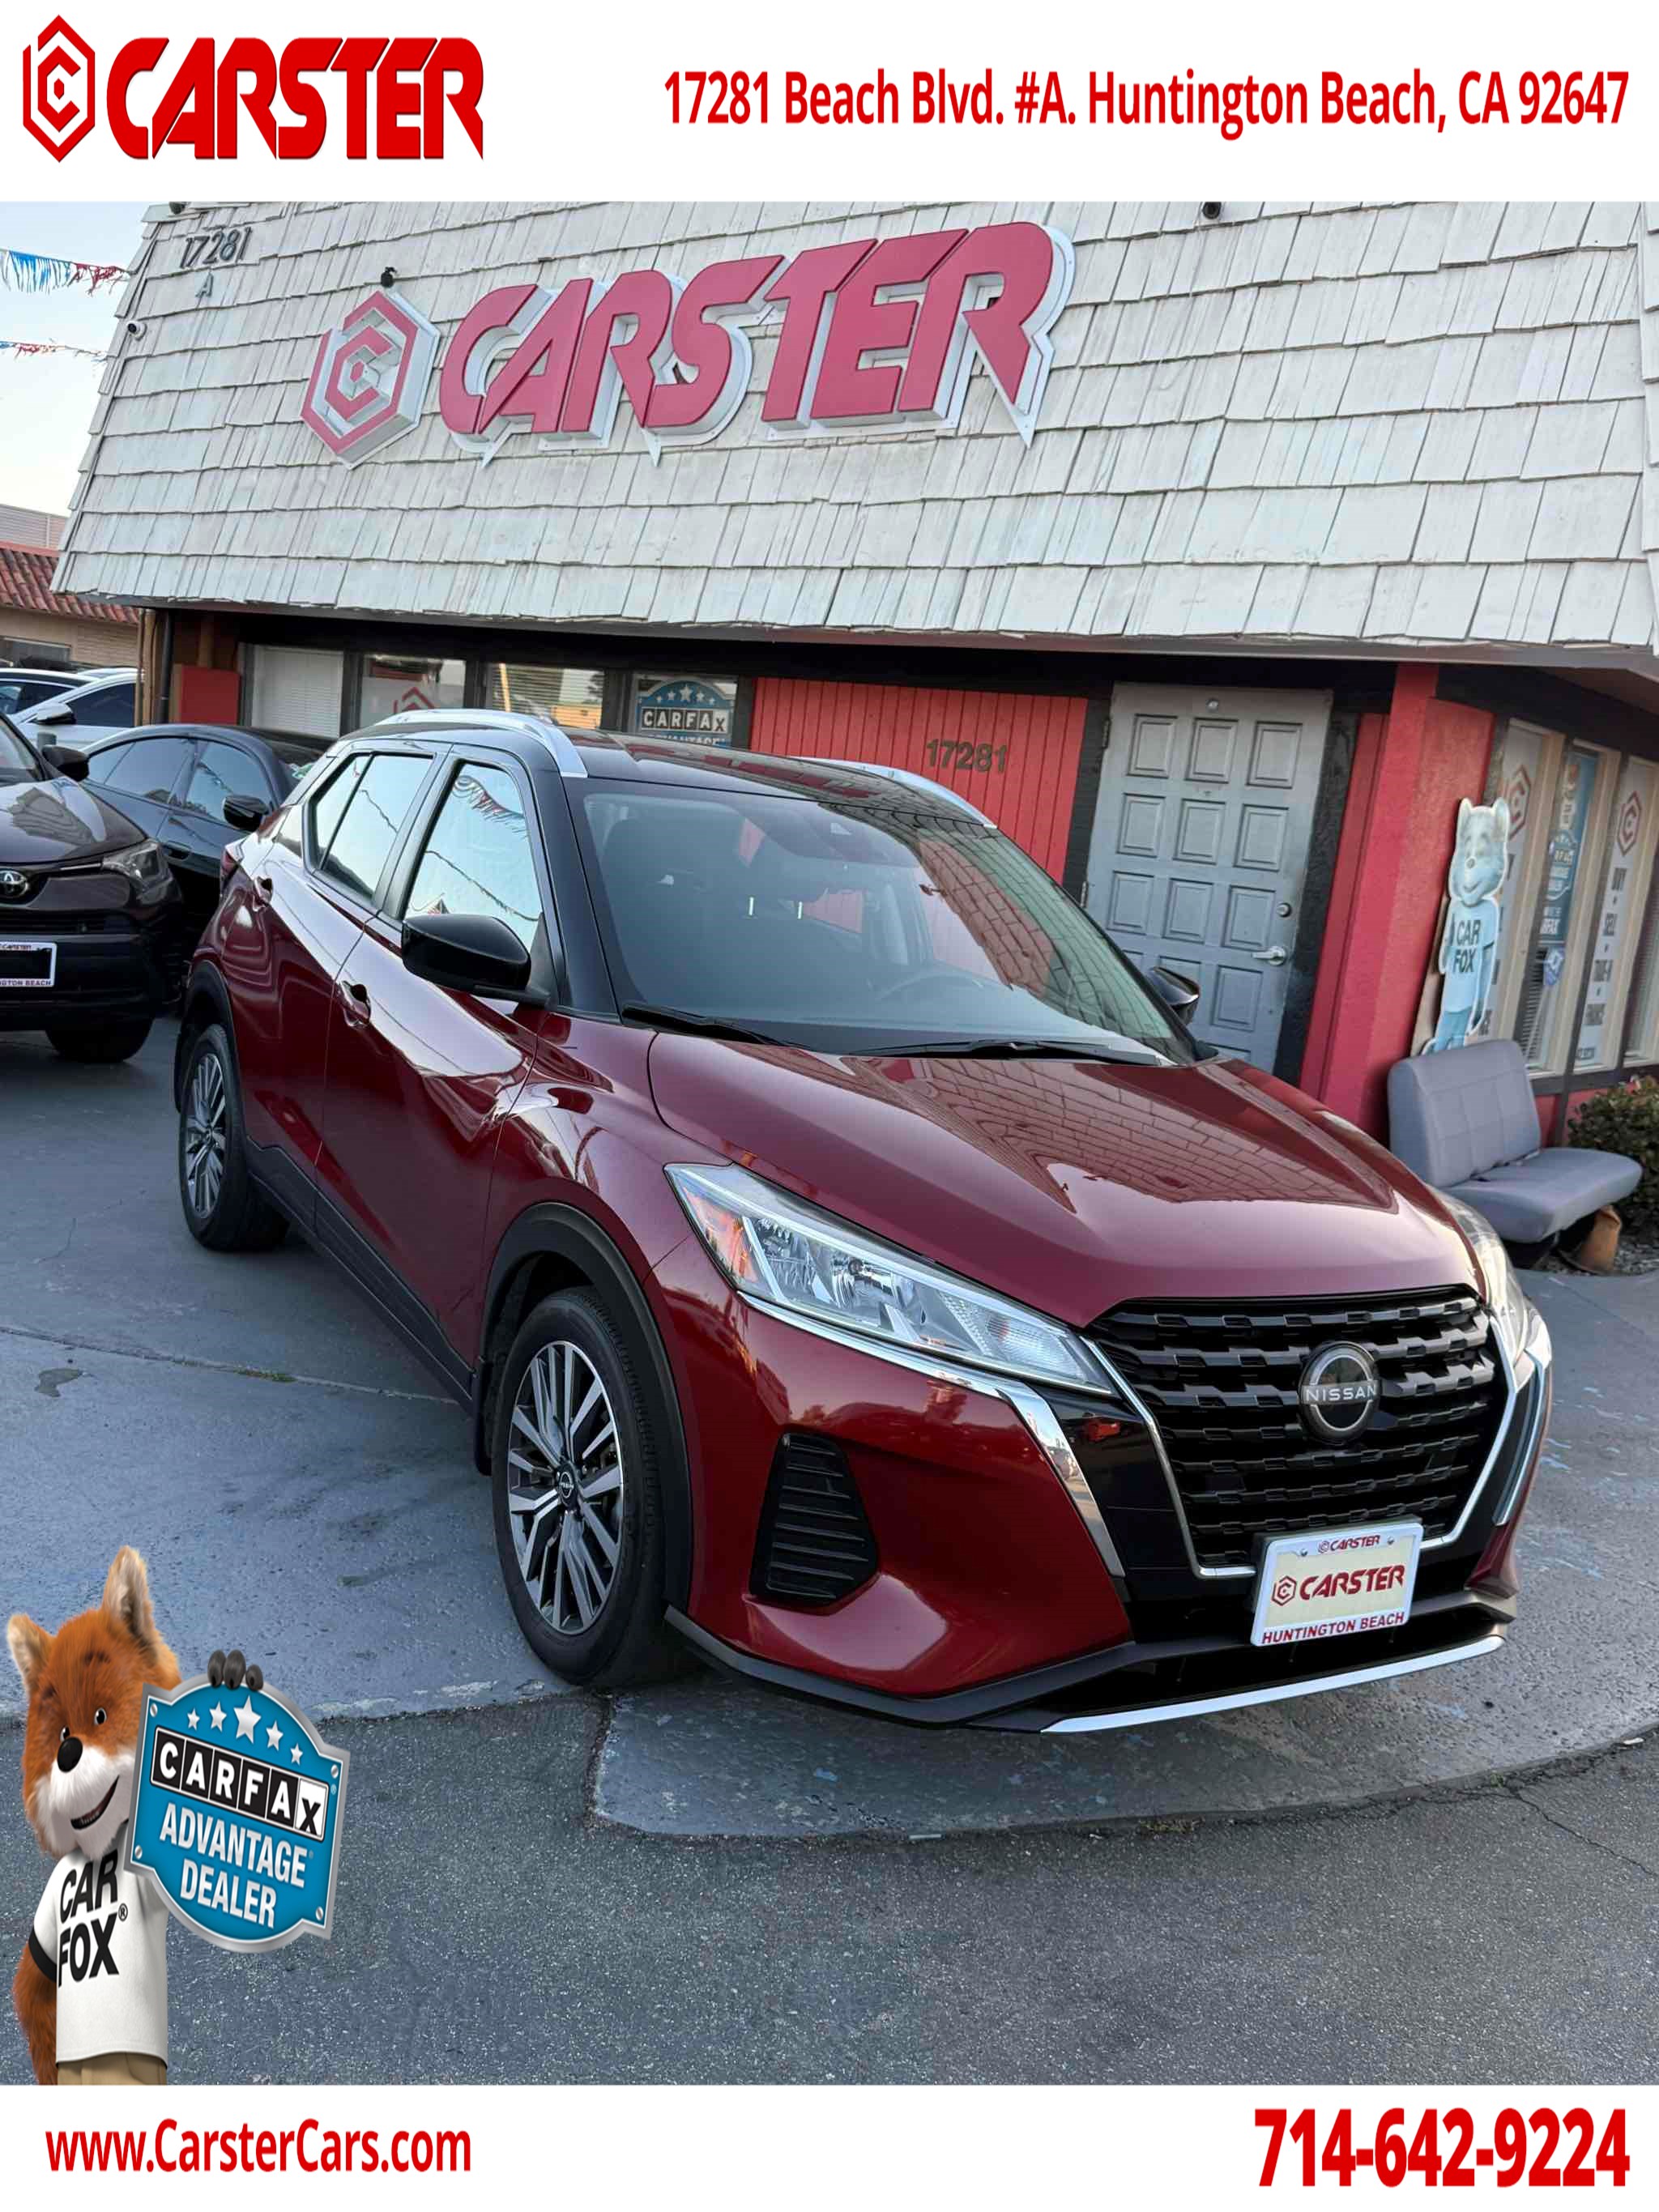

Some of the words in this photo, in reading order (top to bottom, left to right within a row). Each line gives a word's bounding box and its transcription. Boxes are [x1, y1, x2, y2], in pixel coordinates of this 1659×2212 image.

[180, 226, 252, 269] 17281
[195, 272, 214, 297] A
[439, 221, 1063, 441] CARSTER
[643, 710, 725, 731] CARFAX
[926, 738, 1007, 774] 17281
[1456, 919, 1481, 946] CAR
[1452, 948, 1476, 973] FOX
[1306, 1384, 1375, 1402] NISSAN
[1330, 1535, 1380, 1552] CARSTER
[1299, 1565, 1405, 1601] CARSTER
[1262, 1619, 1356, 1644] HUNTINGTON
[1360, 1612, 1405, 1630] BEACH
